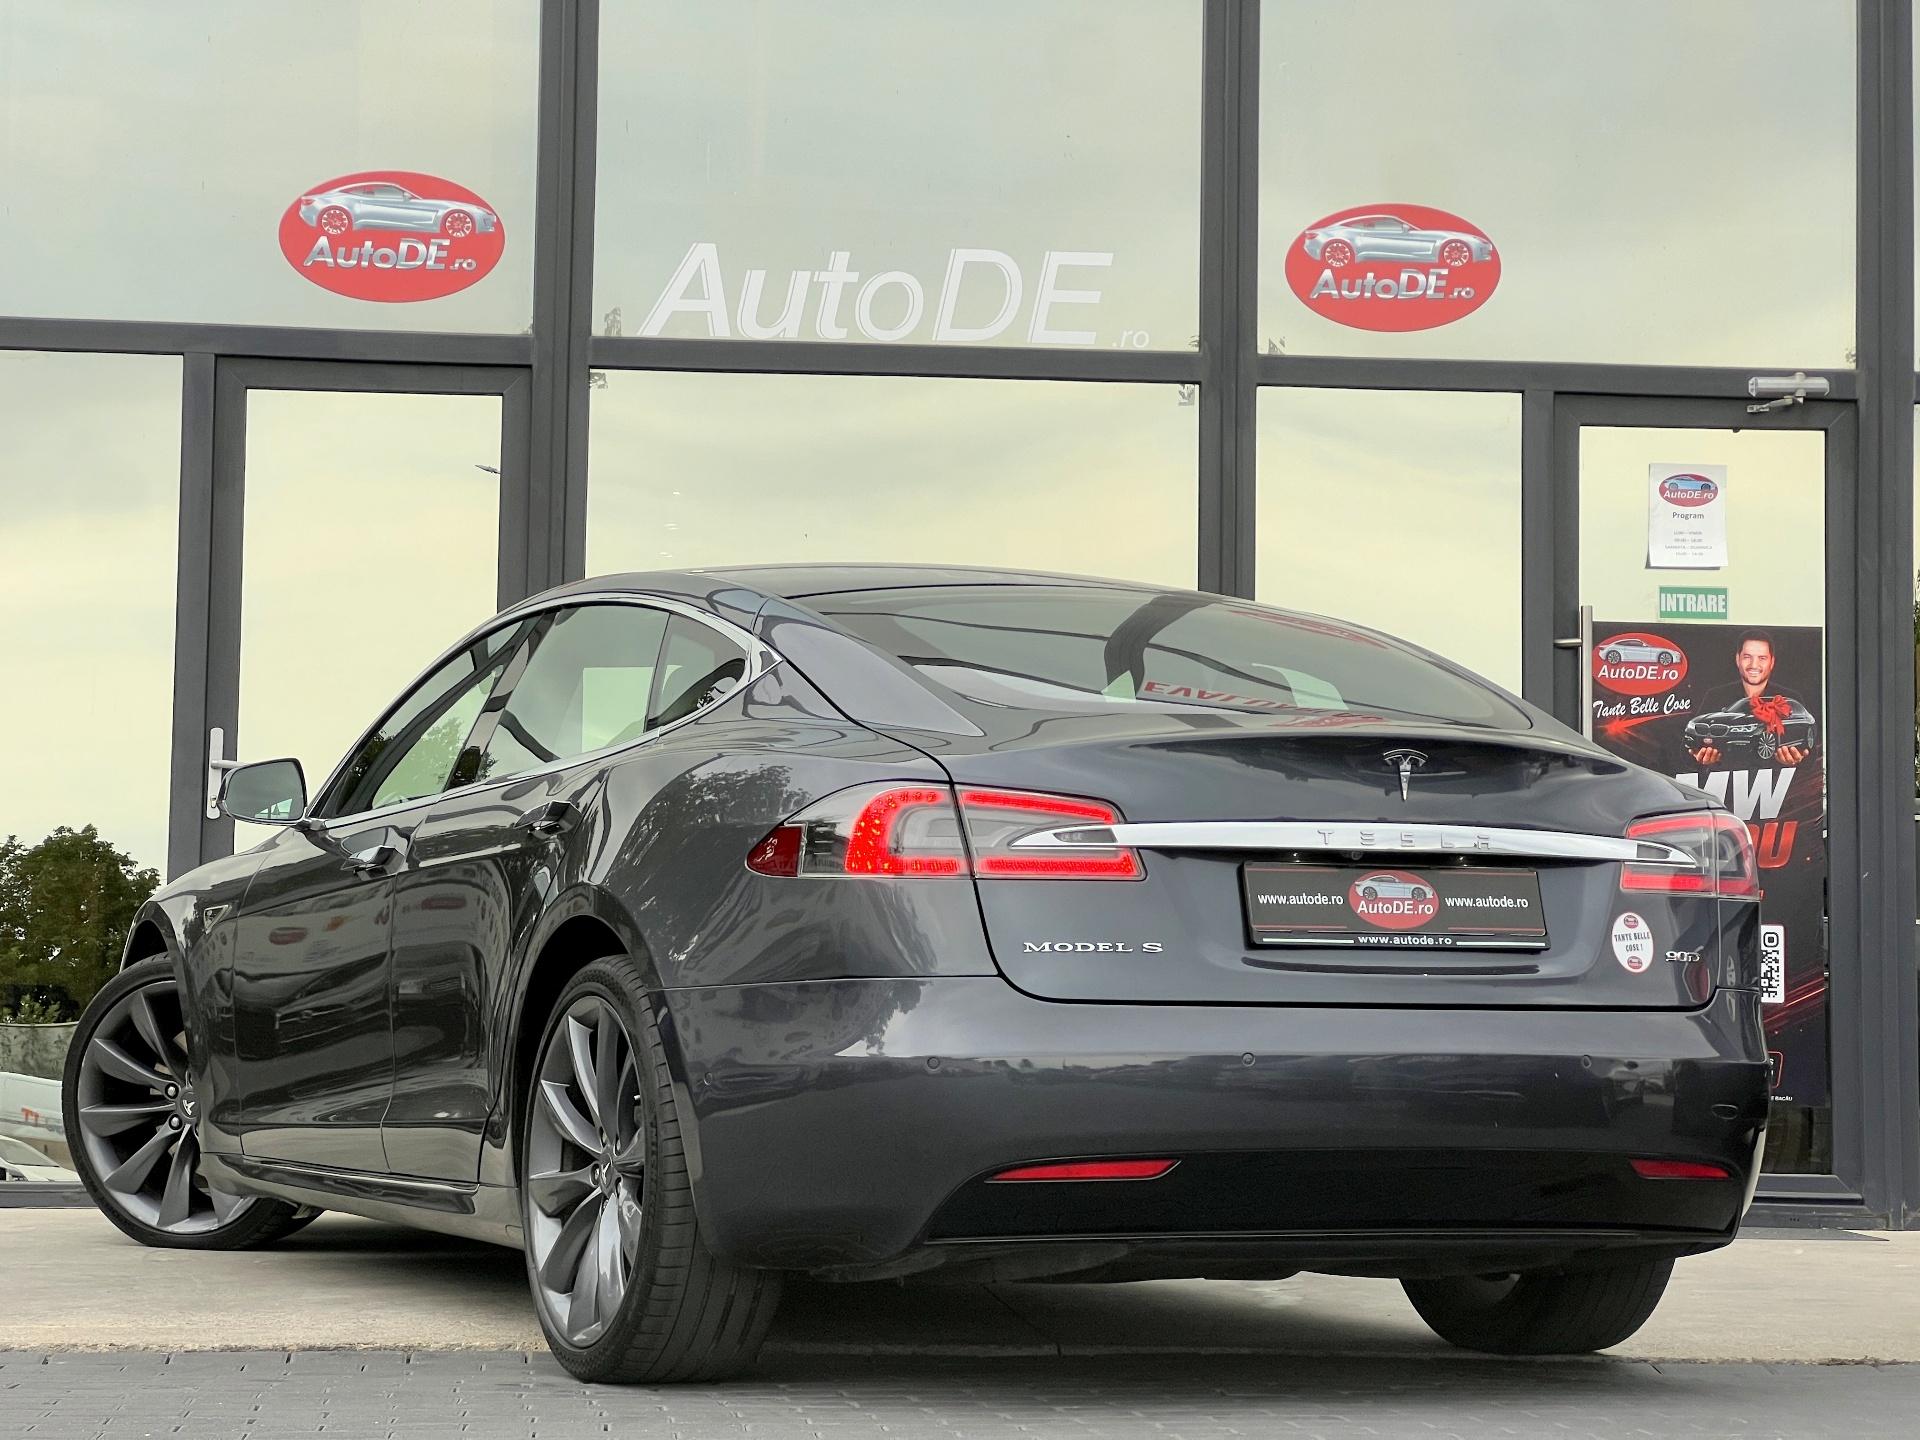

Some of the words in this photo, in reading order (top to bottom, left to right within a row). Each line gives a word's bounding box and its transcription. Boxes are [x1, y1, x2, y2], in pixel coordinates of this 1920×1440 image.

[1672, 511, 1705, 520] Program
[1660, 593, 1726, 613] INTRARE
[1597, 664, 1679, 680] AutoDE.ro
[1592, 700, 1626, 718] Tante
[1629, 696, 1659, 715] Belle
[1663, 693, 1691, 714] Cose
[1317, 829, 1491, 850] TESLA
[1257, 892, 1344, 906] www.autode.ro
[1445, 894, 1529, 909] www.autode.ro
[1356, 900, 1434, 915] AutoDE.ro
[1357, 935, 1453, 946] www.autode.ro
[1614, 932, 1632, 942] TANTE
[1023, 942, 1134, 953] MODEL
[1142, 942, 1164, 953] S
